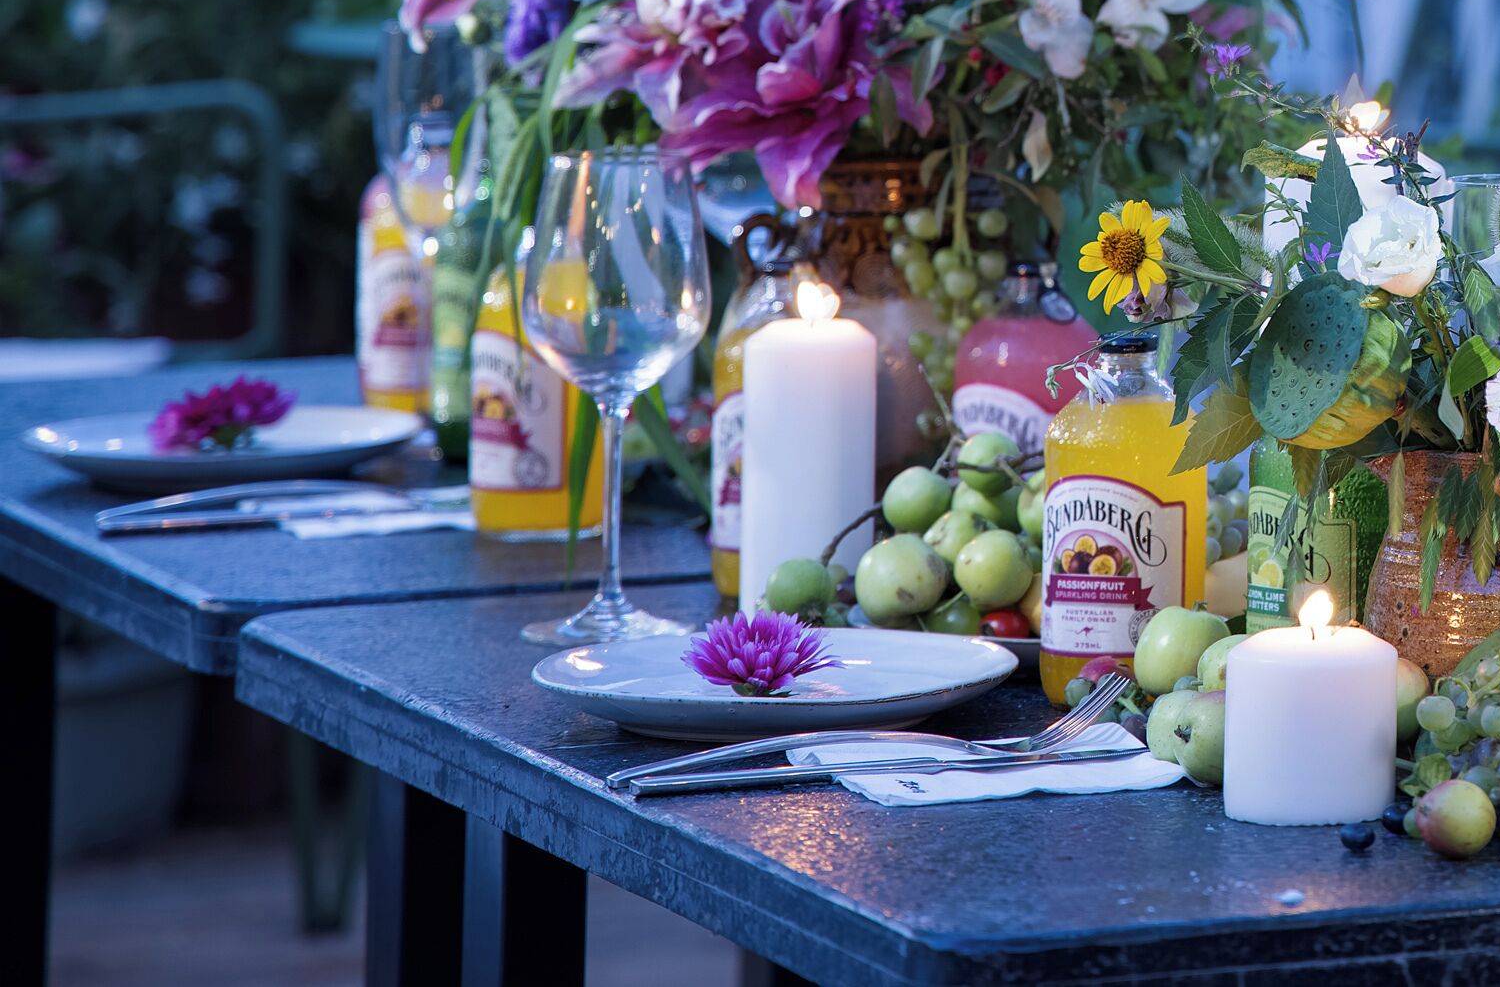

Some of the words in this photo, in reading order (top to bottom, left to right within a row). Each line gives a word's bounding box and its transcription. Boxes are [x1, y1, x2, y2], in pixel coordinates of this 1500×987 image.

[1043, 493, 1168, 568] BUNDABERG
[1057, 579, 1126, 592] PASSIONFRUIT
[1055, 590, 1097, 600] SPARKLING
[1099, 591, 1129, 601] DRINK
[1265, 591, 1286, 603] LIME
[1065, 608, 1115, 616] AUSTRALIAN
[1061, 615, 1086, 623] FAMILY
[1086, 616, 1118, 624] OWNED
